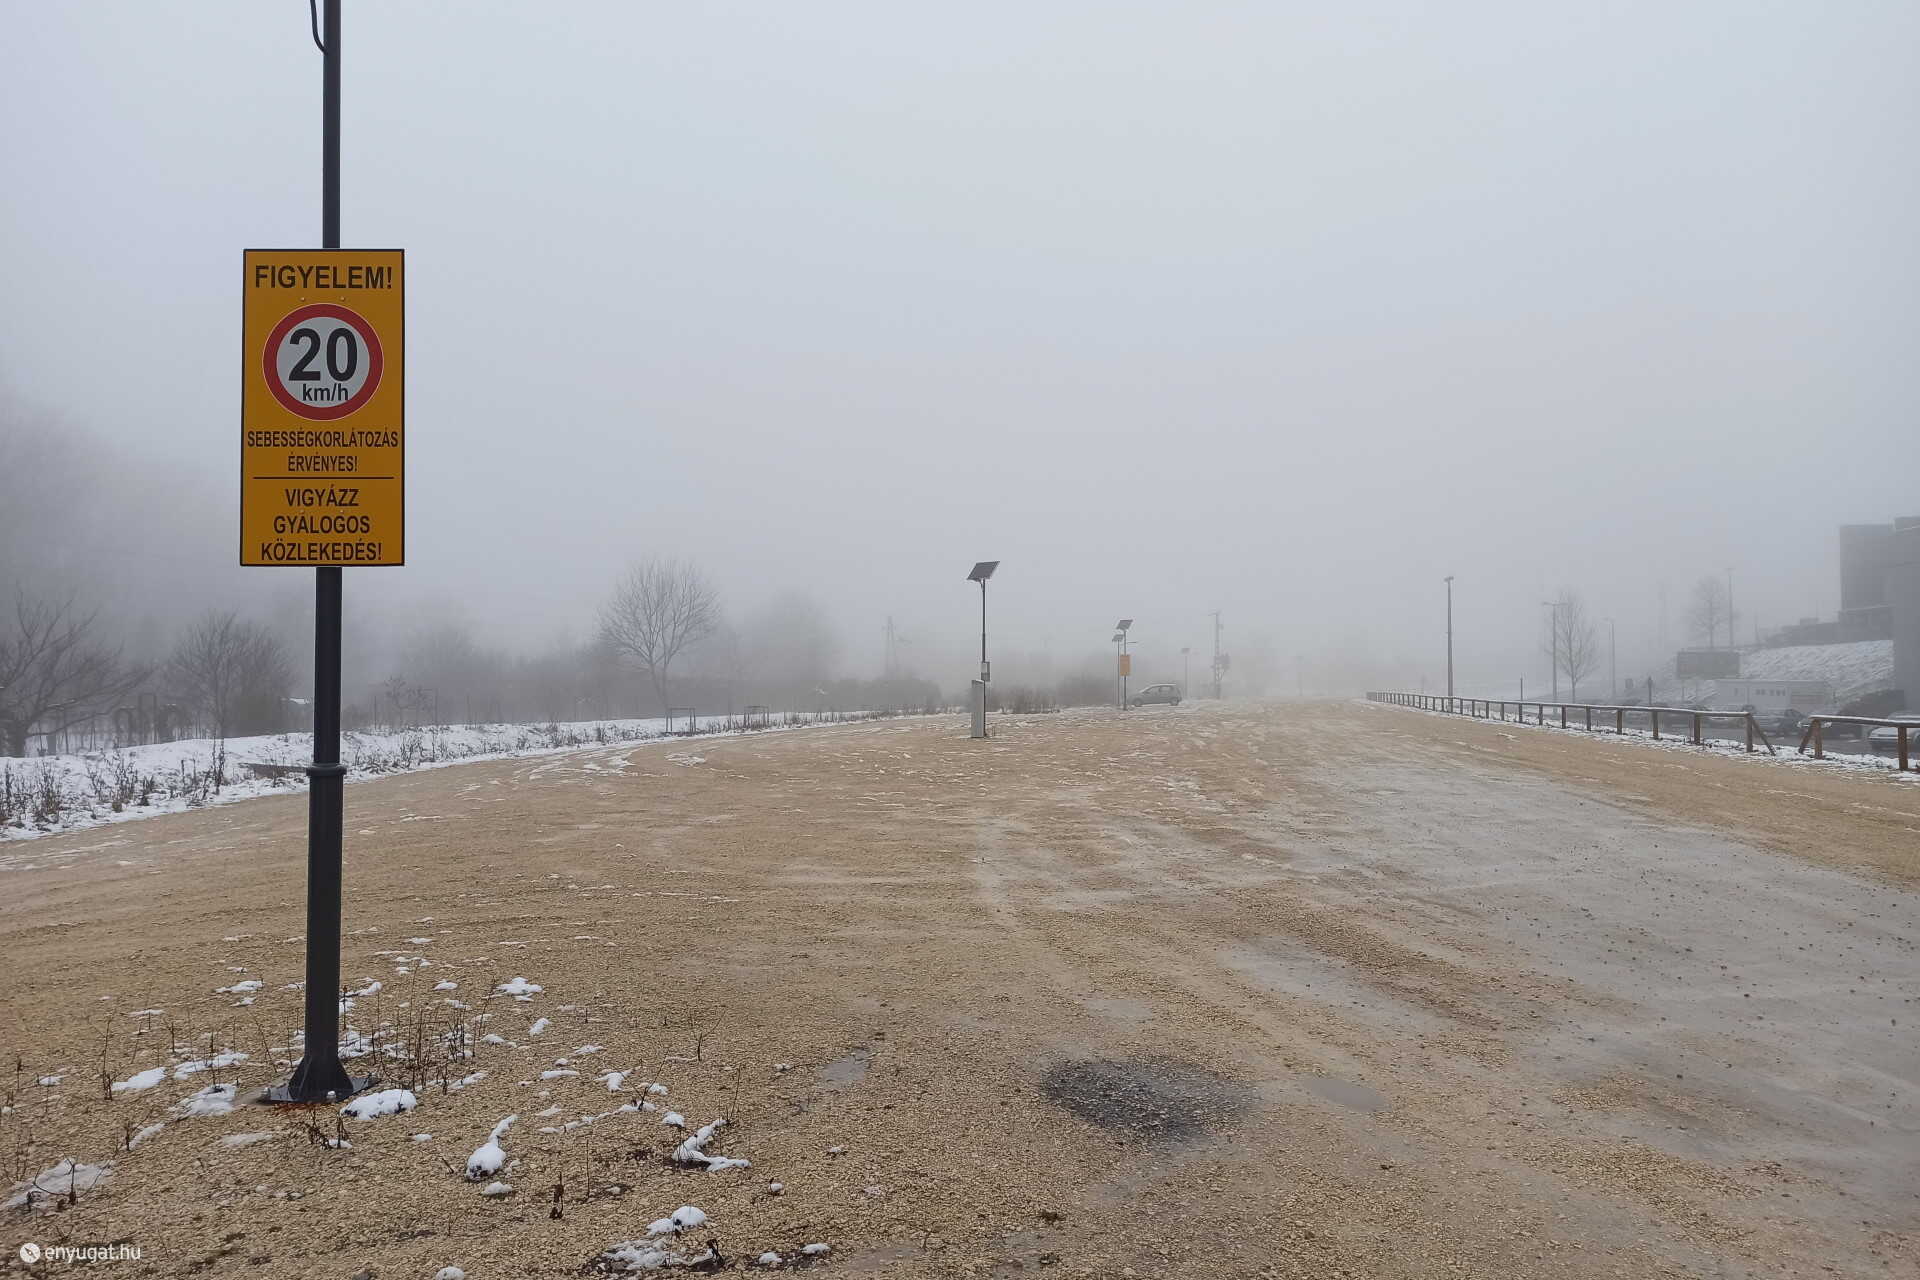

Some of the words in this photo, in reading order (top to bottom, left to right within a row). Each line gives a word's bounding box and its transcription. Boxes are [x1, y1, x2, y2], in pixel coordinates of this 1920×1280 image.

[255, 264, 392, 289] FIGYELEM!
[288, 327, 358, 382] 20
[302, 384, 349, 402] km/h
[247, 427, 399, 448] SEBESSÉGKORLÁTOZÁS
[288, 451, 358, 472] ÉRVÉNYES!
[285, 484, 360, 507] VIGYÁZZ
[261, 538, 383, 561] KÖZLEKEDÉS!
